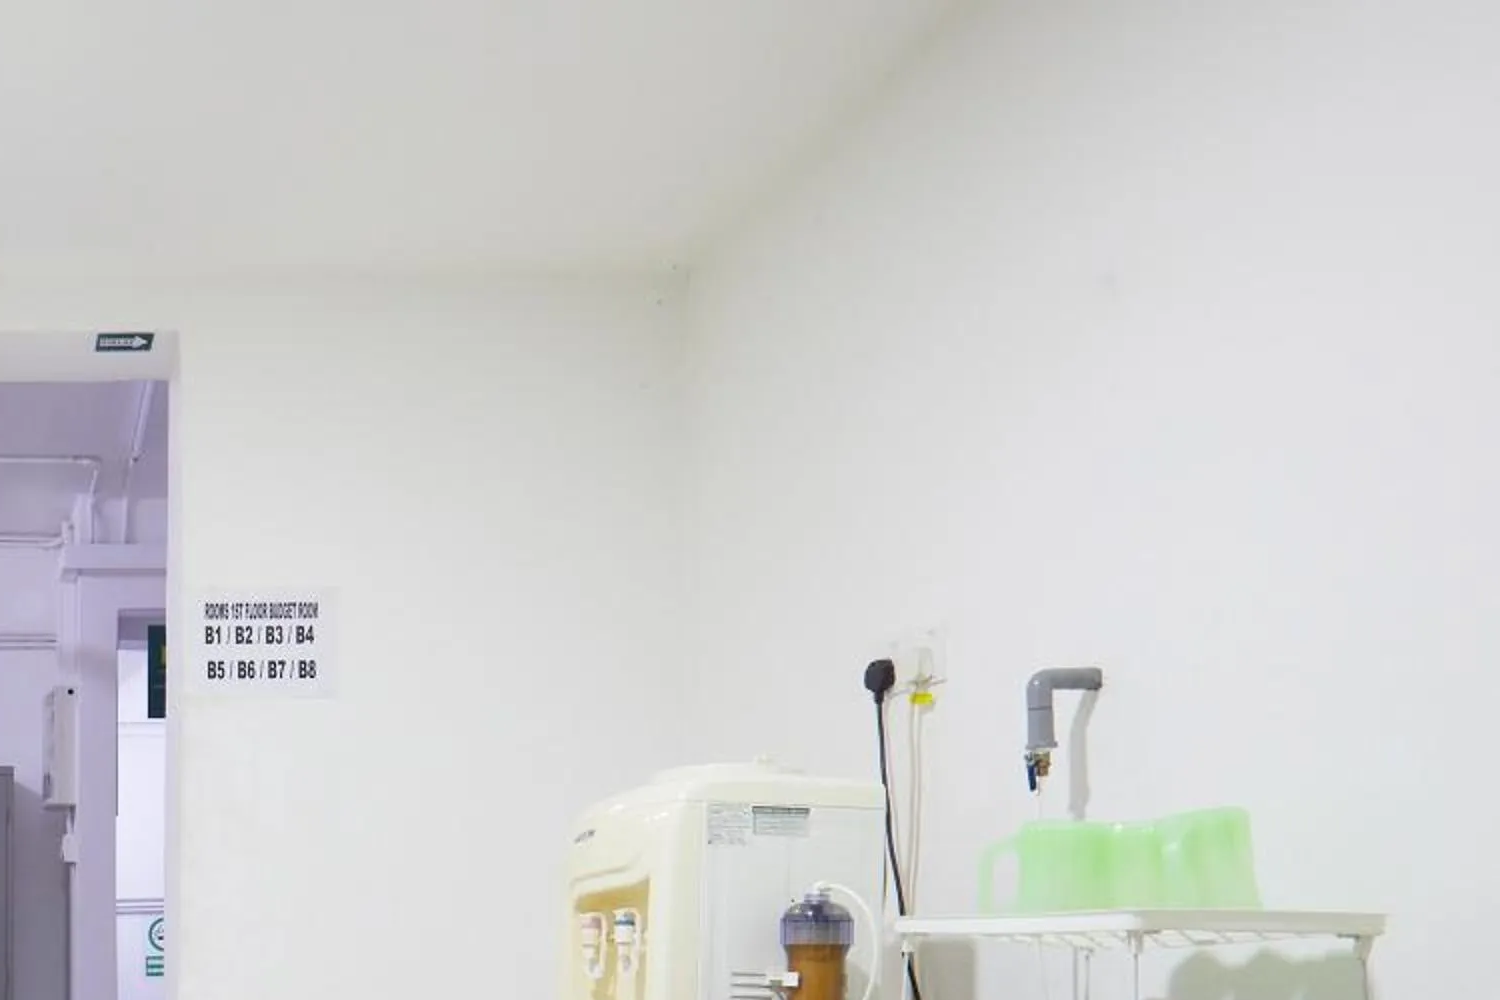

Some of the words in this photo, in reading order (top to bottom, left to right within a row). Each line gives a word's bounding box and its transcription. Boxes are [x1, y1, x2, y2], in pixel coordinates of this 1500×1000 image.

[205, 602, 229, 619] ROOMS
[231, 602, 243, 619] 1ST
[245, 602, 268, 619] FLOOR
[269, 602, 297, 619] BUDGET
[298, 602, 319, 619] ROOM
[205, 626, 221, 644] B1
[235, 626, 253, 644] B2
[265, 626, 283, 644] B3
[295, 626, 314, 644] B4
[207, 661, 225, 679] B5
[237, 661, 255, 679] B6
[267, 661, 286, 679] B7
[298, 660, 317, 679] B8
